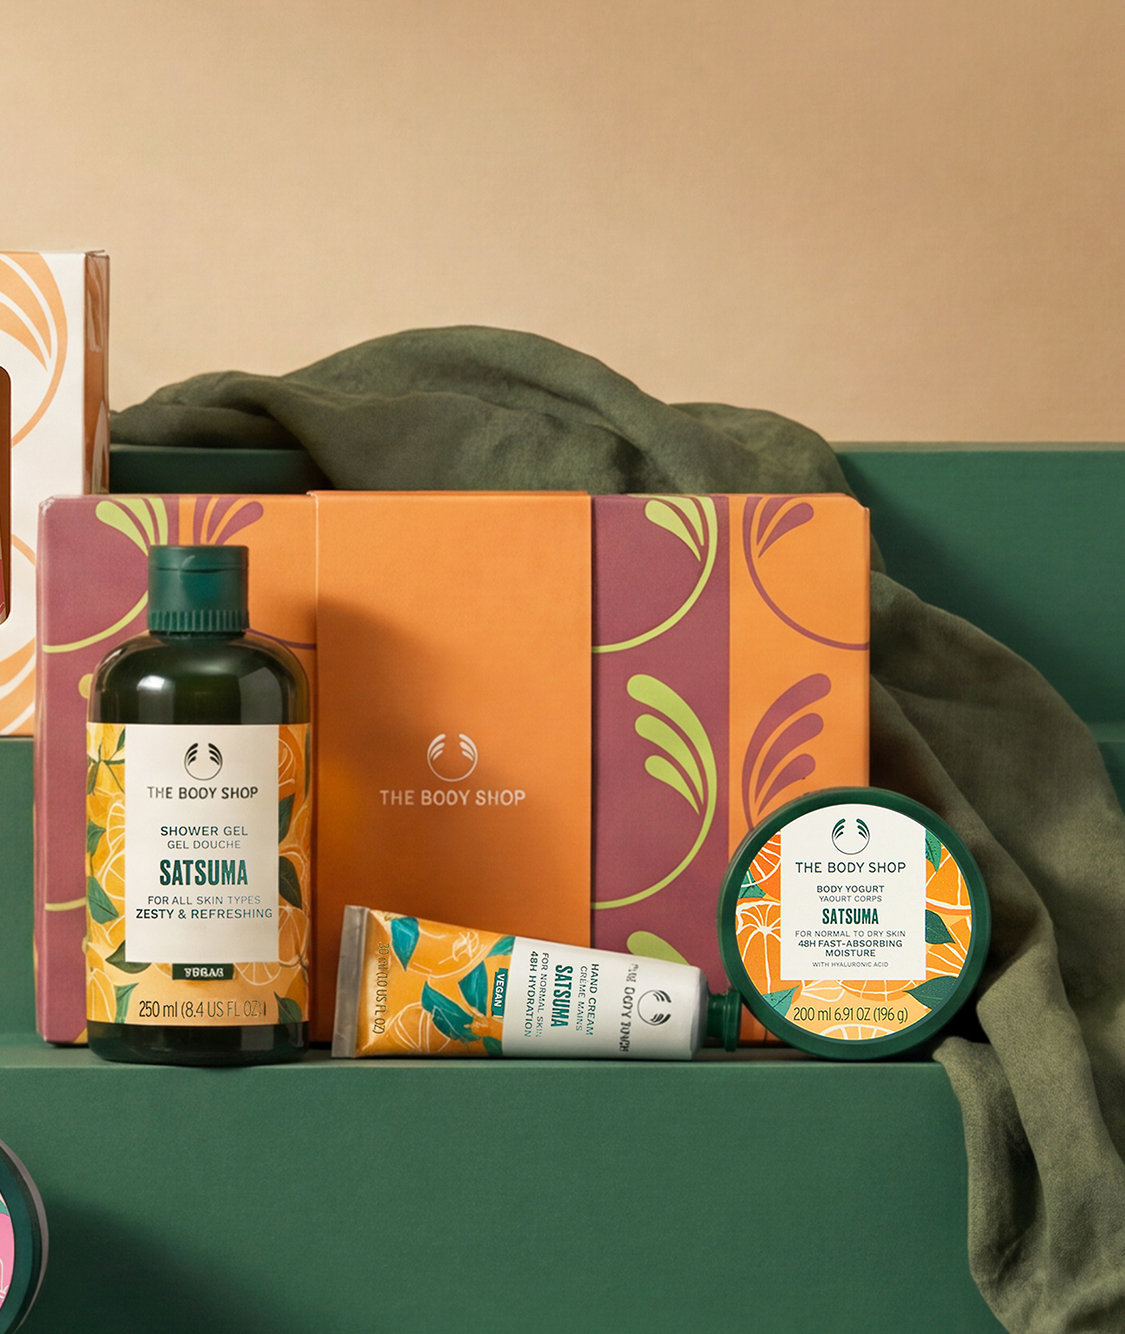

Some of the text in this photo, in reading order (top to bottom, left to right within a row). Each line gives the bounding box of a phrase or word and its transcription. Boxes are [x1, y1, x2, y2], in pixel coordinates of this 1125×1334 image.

[147, 786, 258, 799] THE BODY SHOP
[380, 790, 526, 806] THE BODY SHOP
[160, 826, 248, 836] SHOWER GEL
[167, 840, 241, 849] GEL DOUCHE
[159, 859, 248, 886] SATSUMA
[795, 861, 906, 873] THE BODY SHOP
[816, 885, 885, 893] BODY YOGURT
[147, 895, 261, 905] FOR ALL SKIN TYPES
[819, 895, 882, 903] YAOURT CORPS
[136, 908, 273, 919] ZESTY & REFRESHING
[822, 908, 879, 925] SATSUMA
[795, 930, 906, 938] FOR NORMAL TO DRY SKIN
[798, 940, 903, 948] 48H FAST-ABSORBING
[494, 973, 505, 1007] VEGAN
[524, 950, 539, 1038] 48H HYDRATION
[550, 964, 574, 1027] SATSUMA
[586, 963, 599, 1036] HAND CREAM
[793, 1006, 909, 1024] 200 ml 6.91 OZ (196 g)
